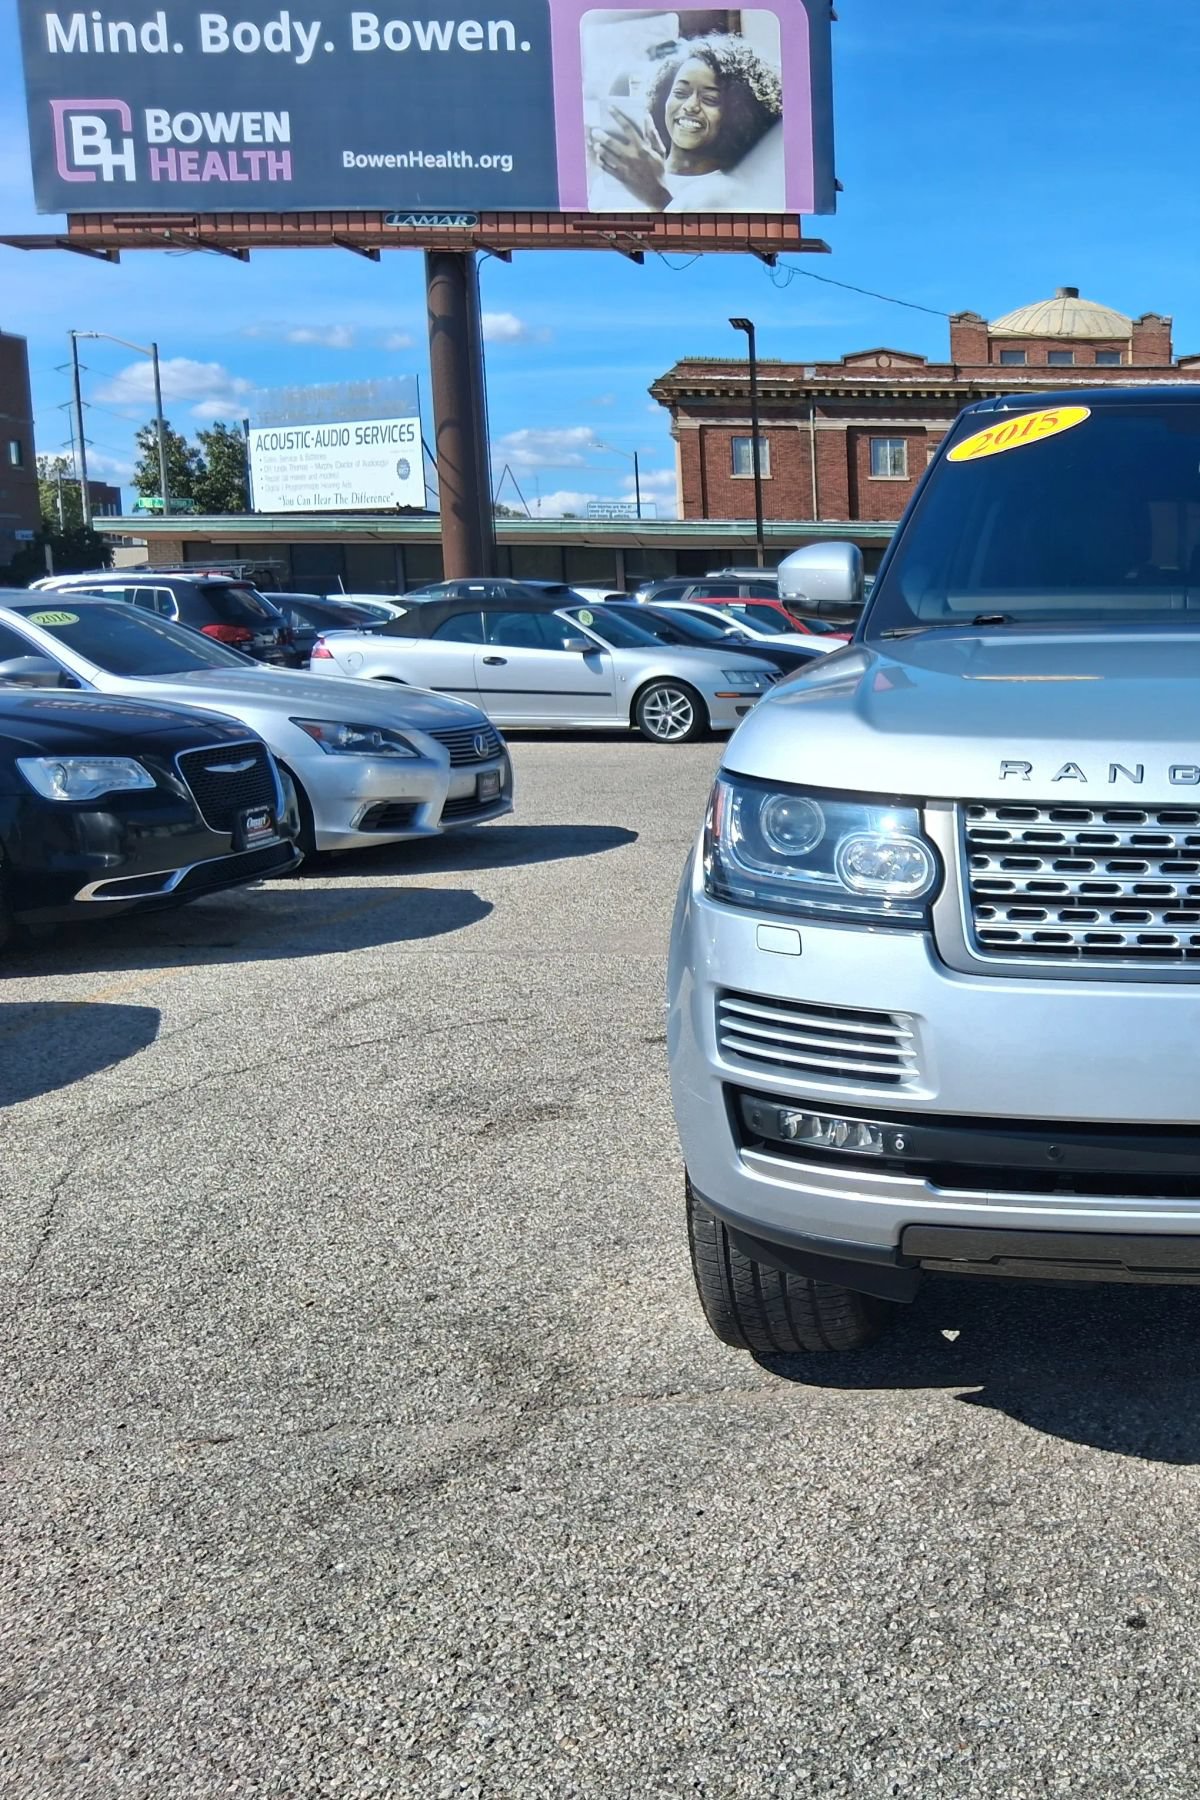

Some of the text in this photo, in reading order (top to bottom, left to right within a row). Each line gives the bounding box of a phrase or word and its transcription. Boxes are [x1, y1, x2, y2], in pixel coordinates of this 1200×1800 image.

[45, 11, 531, 64] Mind. Body. Bowen.
[145, 109, 291, 143] BOWEN
[148, 147, 292, 182] HEALTH
[342, 150, 513, 172] BowenHealth.org
[392, 214, 468, 225] LAMAR
[355, 423, 415, 445] SERVICES
[968, 411, 1060, 456] 2015
[298, 495, 311, 506] Can
[314, 494, 331, 506] Hear
[334, 493, 348, 504] The
[36, 613, 72, 624] 2014
